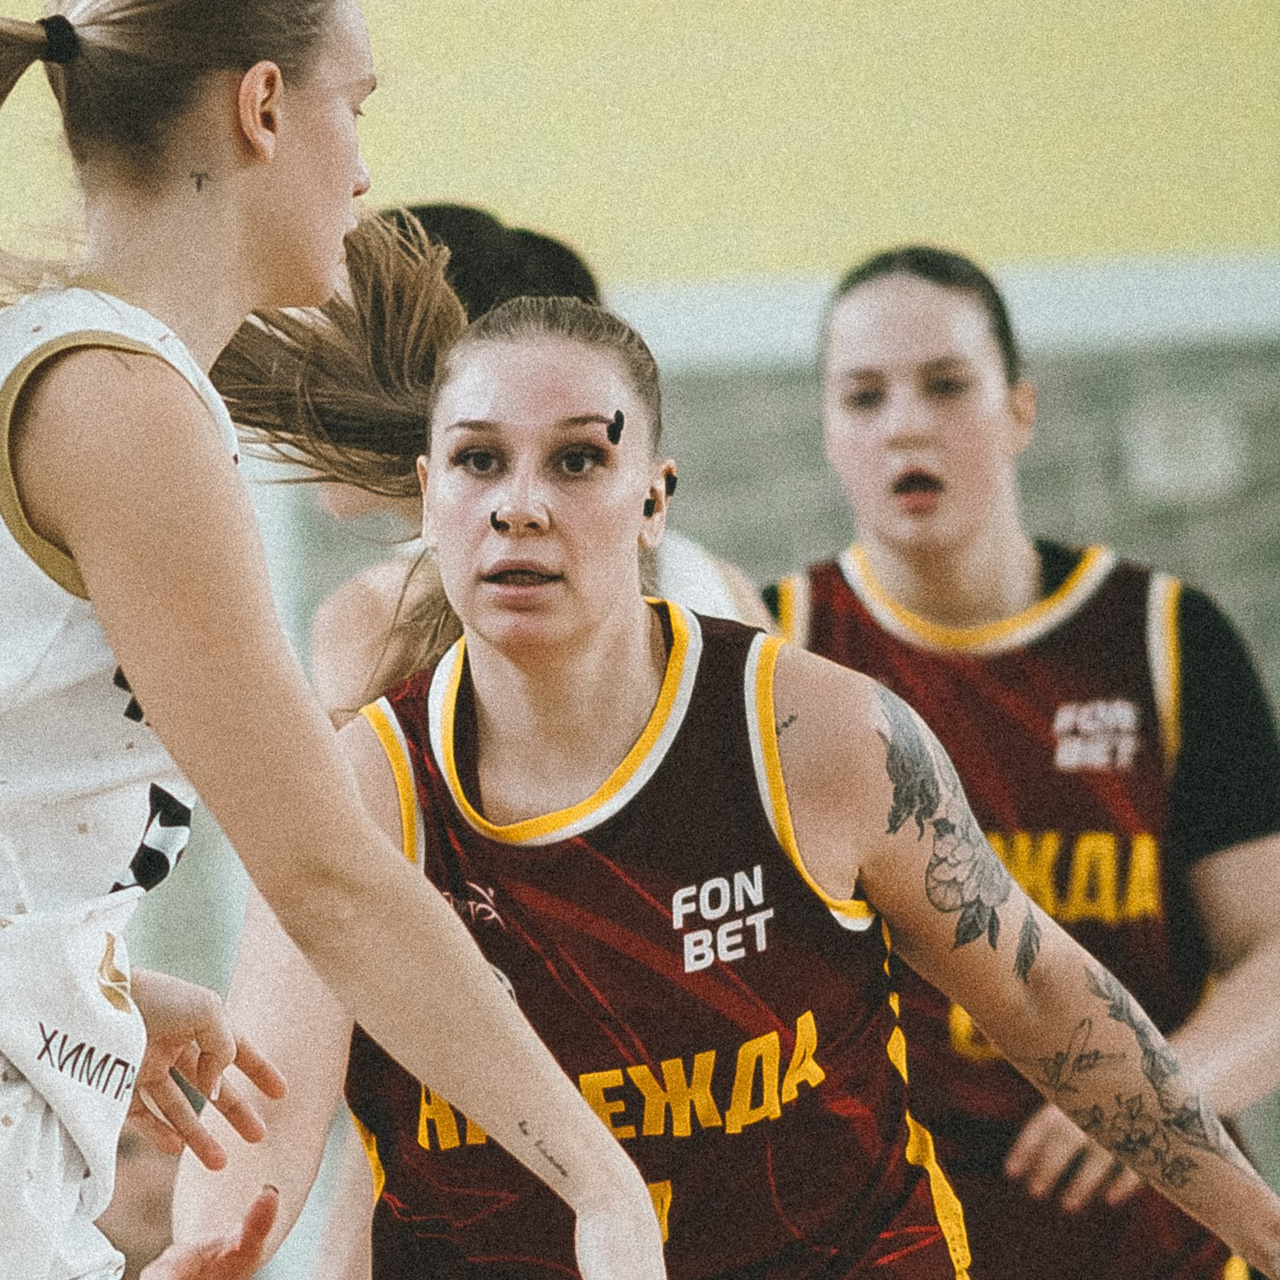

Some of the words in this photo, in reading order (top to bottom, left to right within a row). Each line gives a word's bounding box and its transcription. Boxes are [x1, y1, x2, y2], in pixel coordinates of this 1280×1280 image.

[672, 864, 764, 930] FON
[683, 907, 774, 974] BET
[417, 1010, 826, 1152] НЕЖДА
